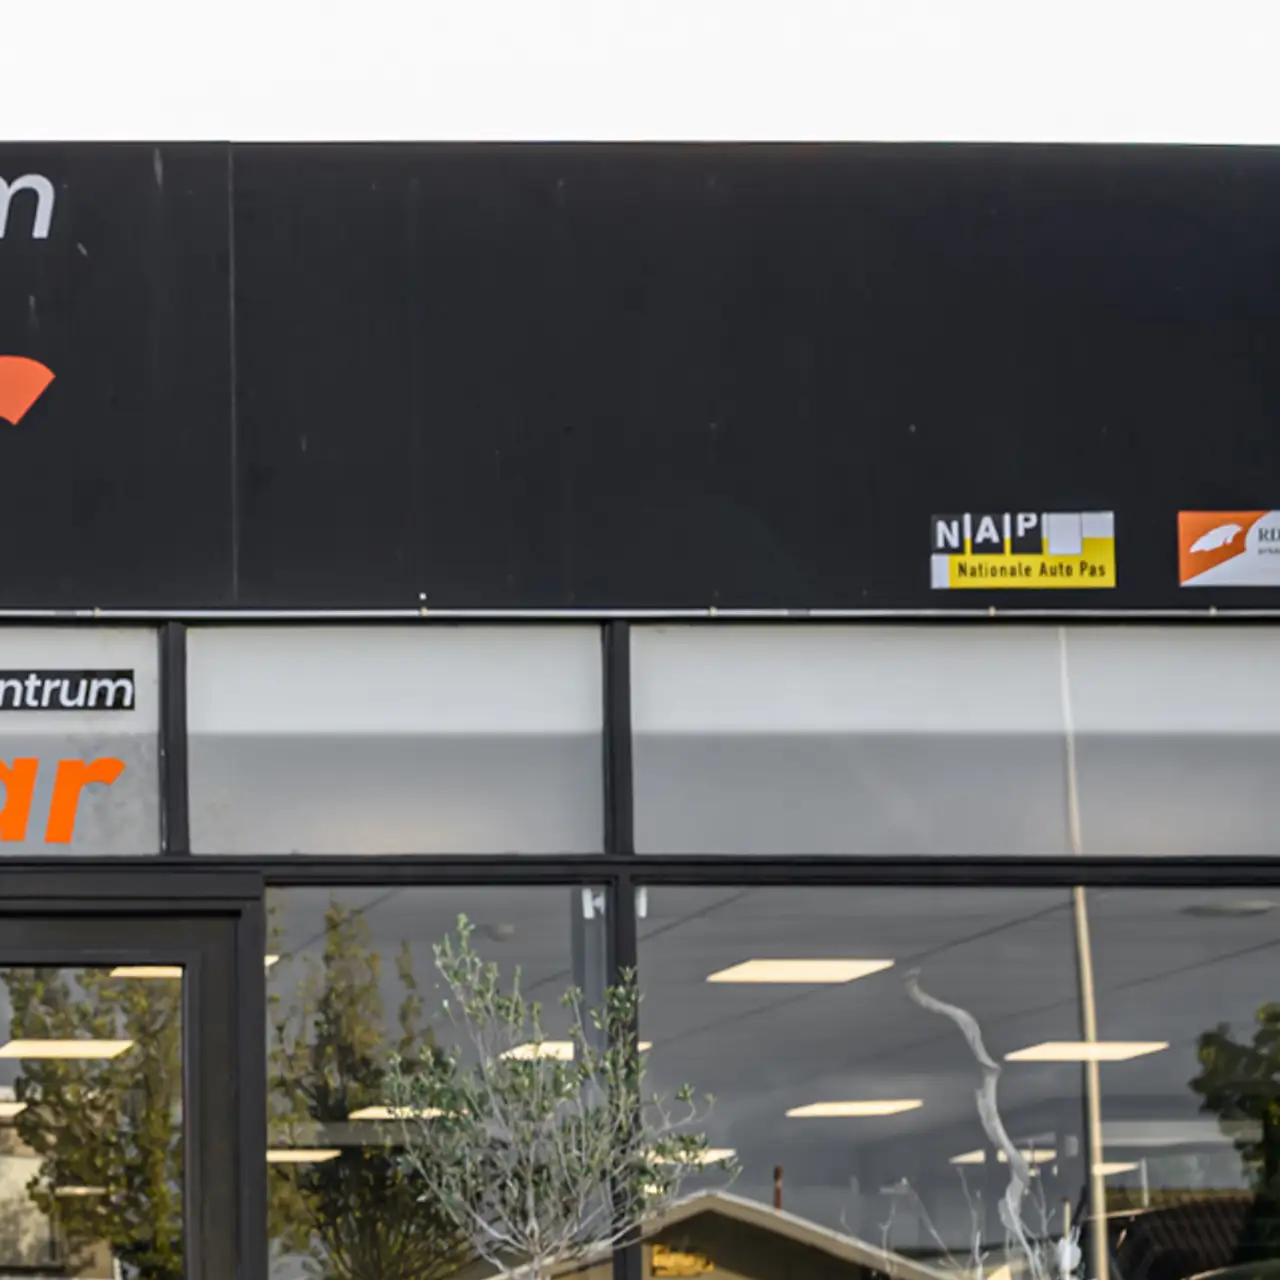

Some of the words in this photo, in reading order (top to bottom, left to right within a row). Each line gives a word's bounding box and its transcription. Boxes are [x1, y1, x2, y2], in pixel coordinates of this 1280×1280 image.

[958, 562, 1032, 578] Nationale
[1039, 561, 1073, 578] Auto
[1080, 561, 1106, 577] Pas
